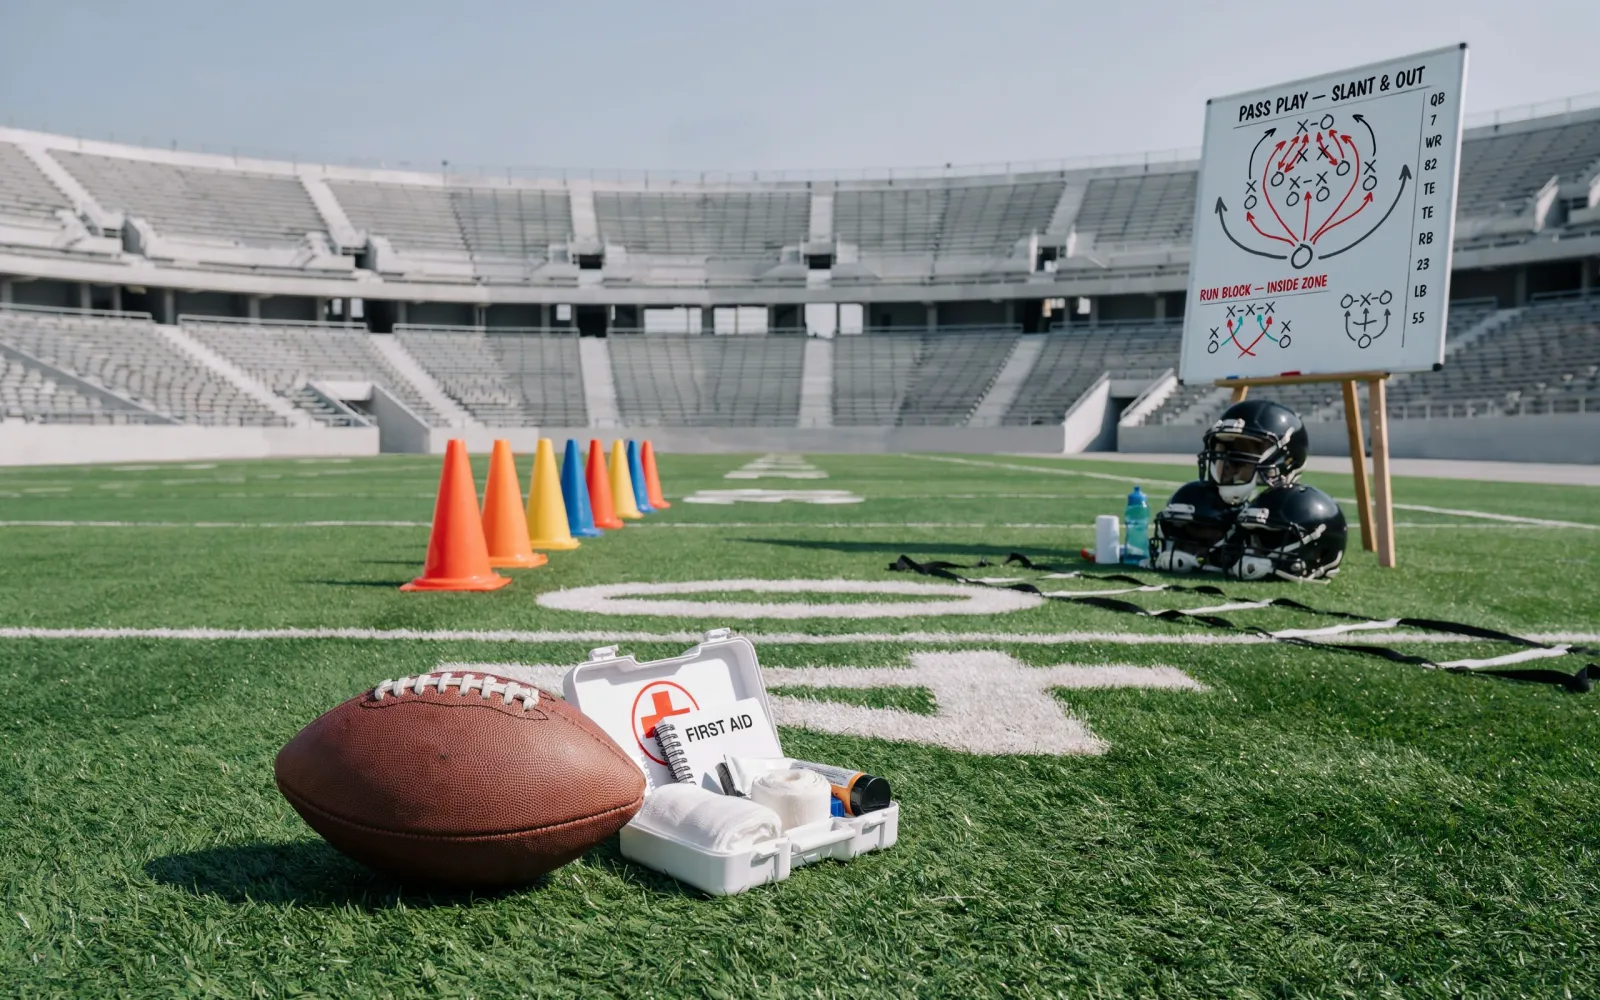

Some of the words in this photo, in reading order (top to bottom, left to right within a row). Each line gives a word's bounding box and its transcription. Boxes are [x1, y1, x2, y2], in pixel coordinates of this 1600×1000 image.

[1238, 99, 1271, 123] PASS
[1275, 91, 1309, 115] PLAY
[1331, 76, 1376, 102] SLANT
[1379, 74, 1391, 92] &
[1395, 65, 1426, 89] OUT
[1430, 91, 1446, 107] QB
[1430, 113, 1438, 126] 7
[1425, 134, 1443, 149] WR
[1424, 157, 1438, 171] 82
[1423, 181, 1436, 196] TE
[1421, 205, 1434, 220] TE
[1418, 231, 1434, 246] RB
[1416, 257, 1430, 271] 23
[1199, 286, 1219, 302] RUN
[1221, 284, 1252, 299] BLOCK
[1266, 277, 1299, 294] INSIDE
[1301, 274, 1328, 290] ZONE
[1414, 283, 1428, 298] LB
[1411, 311, 1426, 325] 55
[685, 719, 725, 743] FIRST
[730, 714, 753, 732] AID
